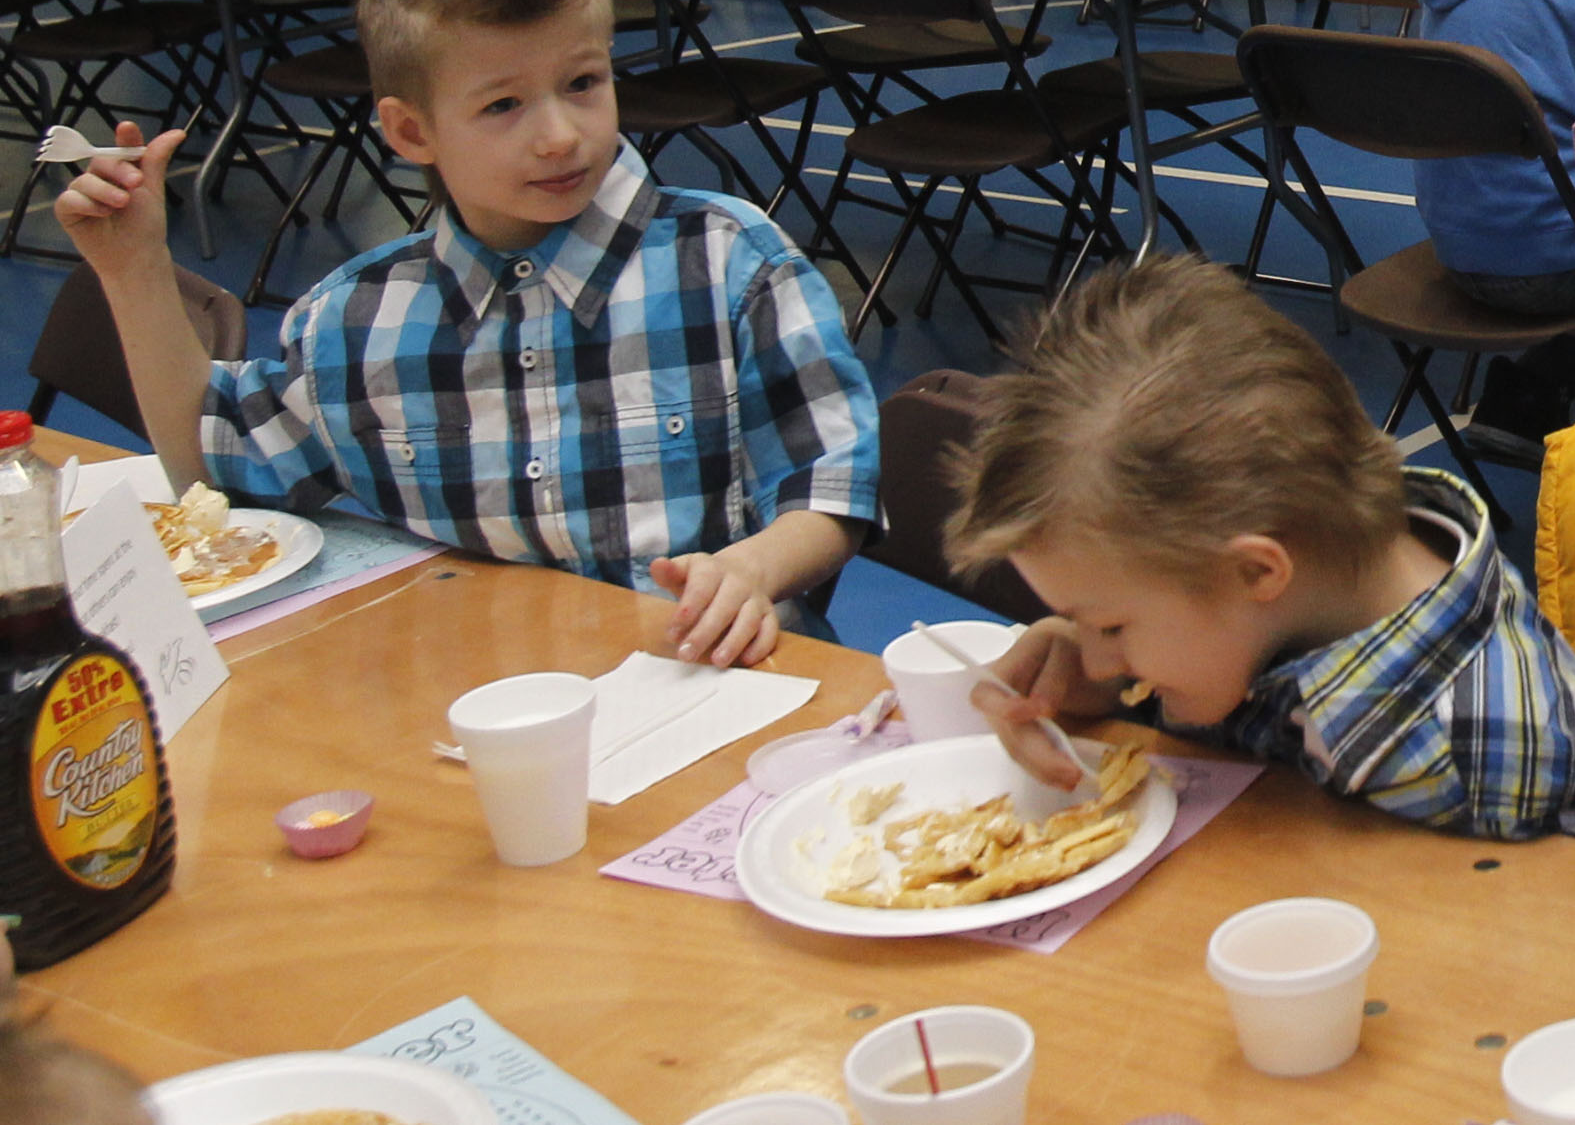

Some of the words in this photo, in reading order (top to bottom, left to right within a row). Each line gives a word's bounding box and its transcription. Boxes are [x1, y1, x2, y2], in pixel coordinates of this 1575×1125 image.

[52, 670, 125, 724] Extra
[66, 660, 105, 693] 50%
[43, 718, 144, 799] Country
[56, 751, 145, 829] Kitchen
